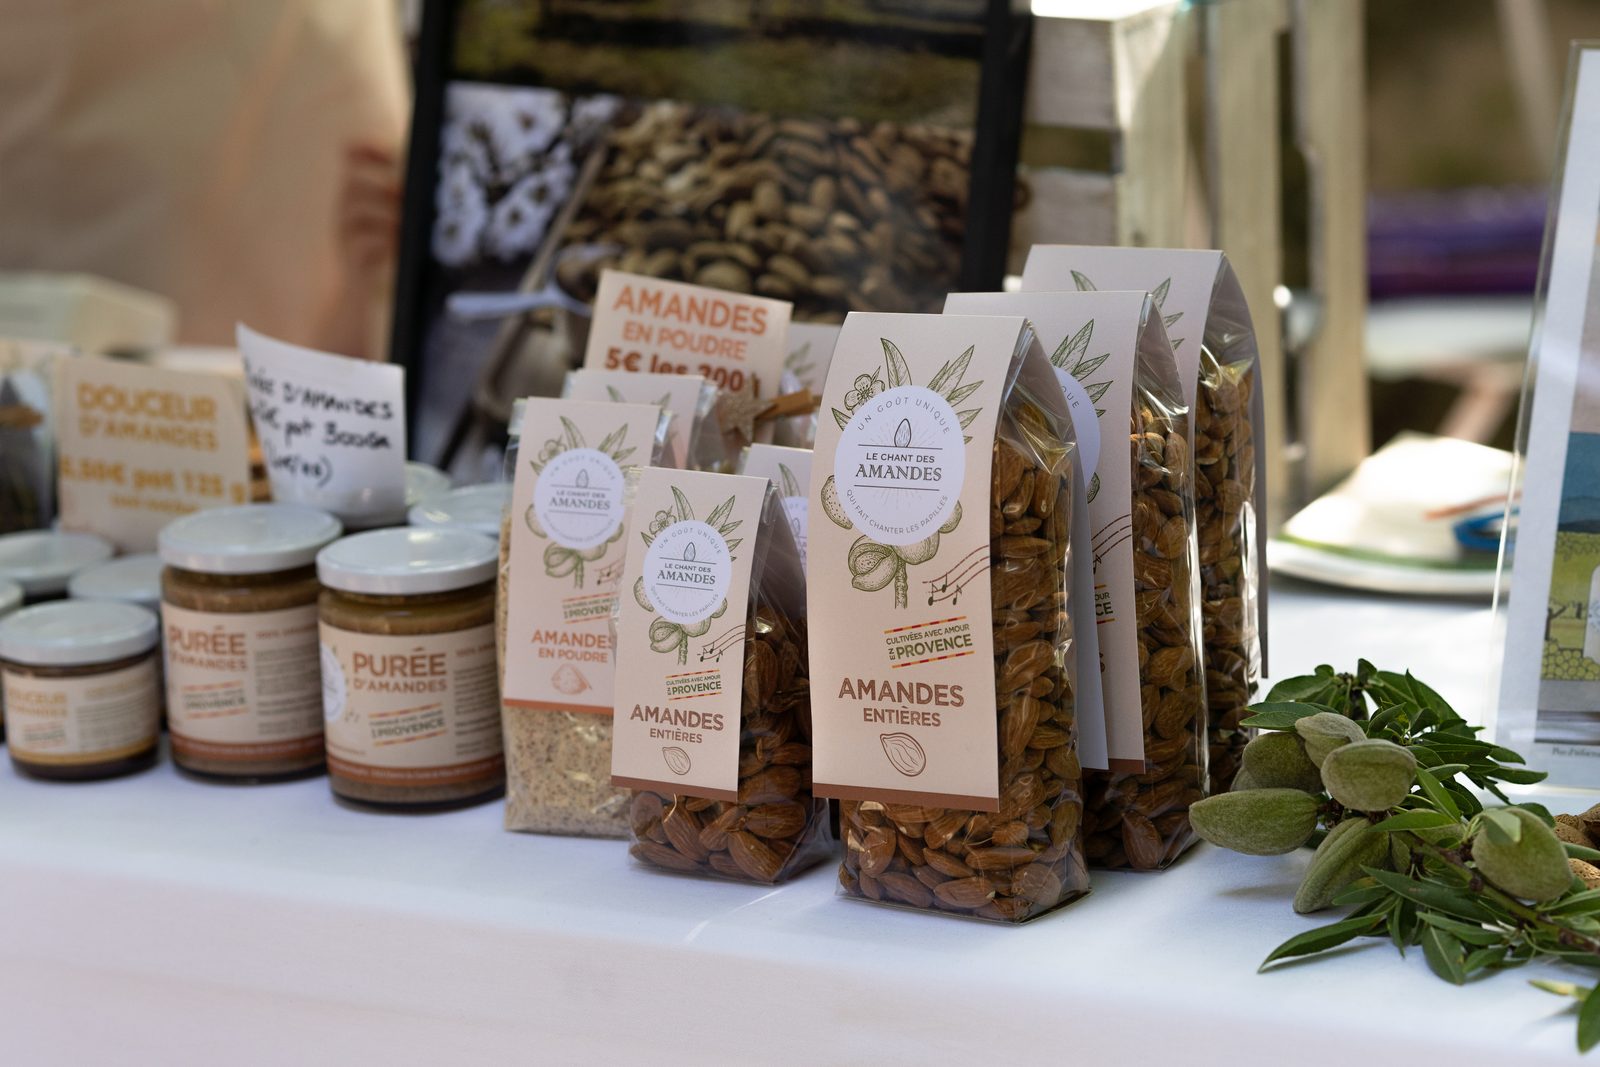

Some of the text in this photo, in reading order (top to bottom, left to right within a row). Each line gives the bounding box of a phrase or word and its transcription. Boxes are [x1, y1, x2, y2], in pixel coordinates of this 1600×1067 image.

[613, 286, 768, 335] AMANDES
[622, 322, 747, 360] EN POUDRE
[605, 347, 642, 372] 5€
[77, 383, 215, 421] DOUCEUR
[857, 396, 950, 434] UN GOÛT UNIQUE
[79, 416, 218, 450] D'AMANDES
[866, 452, 935, 463] LE CHANT DES
[855, 463, 942, 482] AMANDES
[549, 496, 610, 510] AMANDES
[846, 489, 949, 535] QUI FAIT CHANTER LES PAPILLES
[659, 538, 669, 549] UN
[697, 529, 722, 555] UNIQUE
[657, 569, 716, 585] AMANDES
[674, 564, 697, 572] CHANT
[168, 625, 246, 656] PURÉE
[531, 629, 614, 650] AMANDES
[886, 623, 970, 646] CULTIVÉES AVEC AMOUR
[888, 633, 973, 661] EN PROVENCE
[353, 646, 447, 678] PURÉE
[538, 648, 609, 663] EN POUDRE
[353, 678, 447, 694] D'AMANDES
[672, 681, 722, 695] PROVENCE
[838, 677, 965, 708] AMANDES
[630, 704, 724, 731] AMANDES
[863, 706, 941, 727] ENTIÈRES
[649, 728, 703, 744] ENTIÈRES
